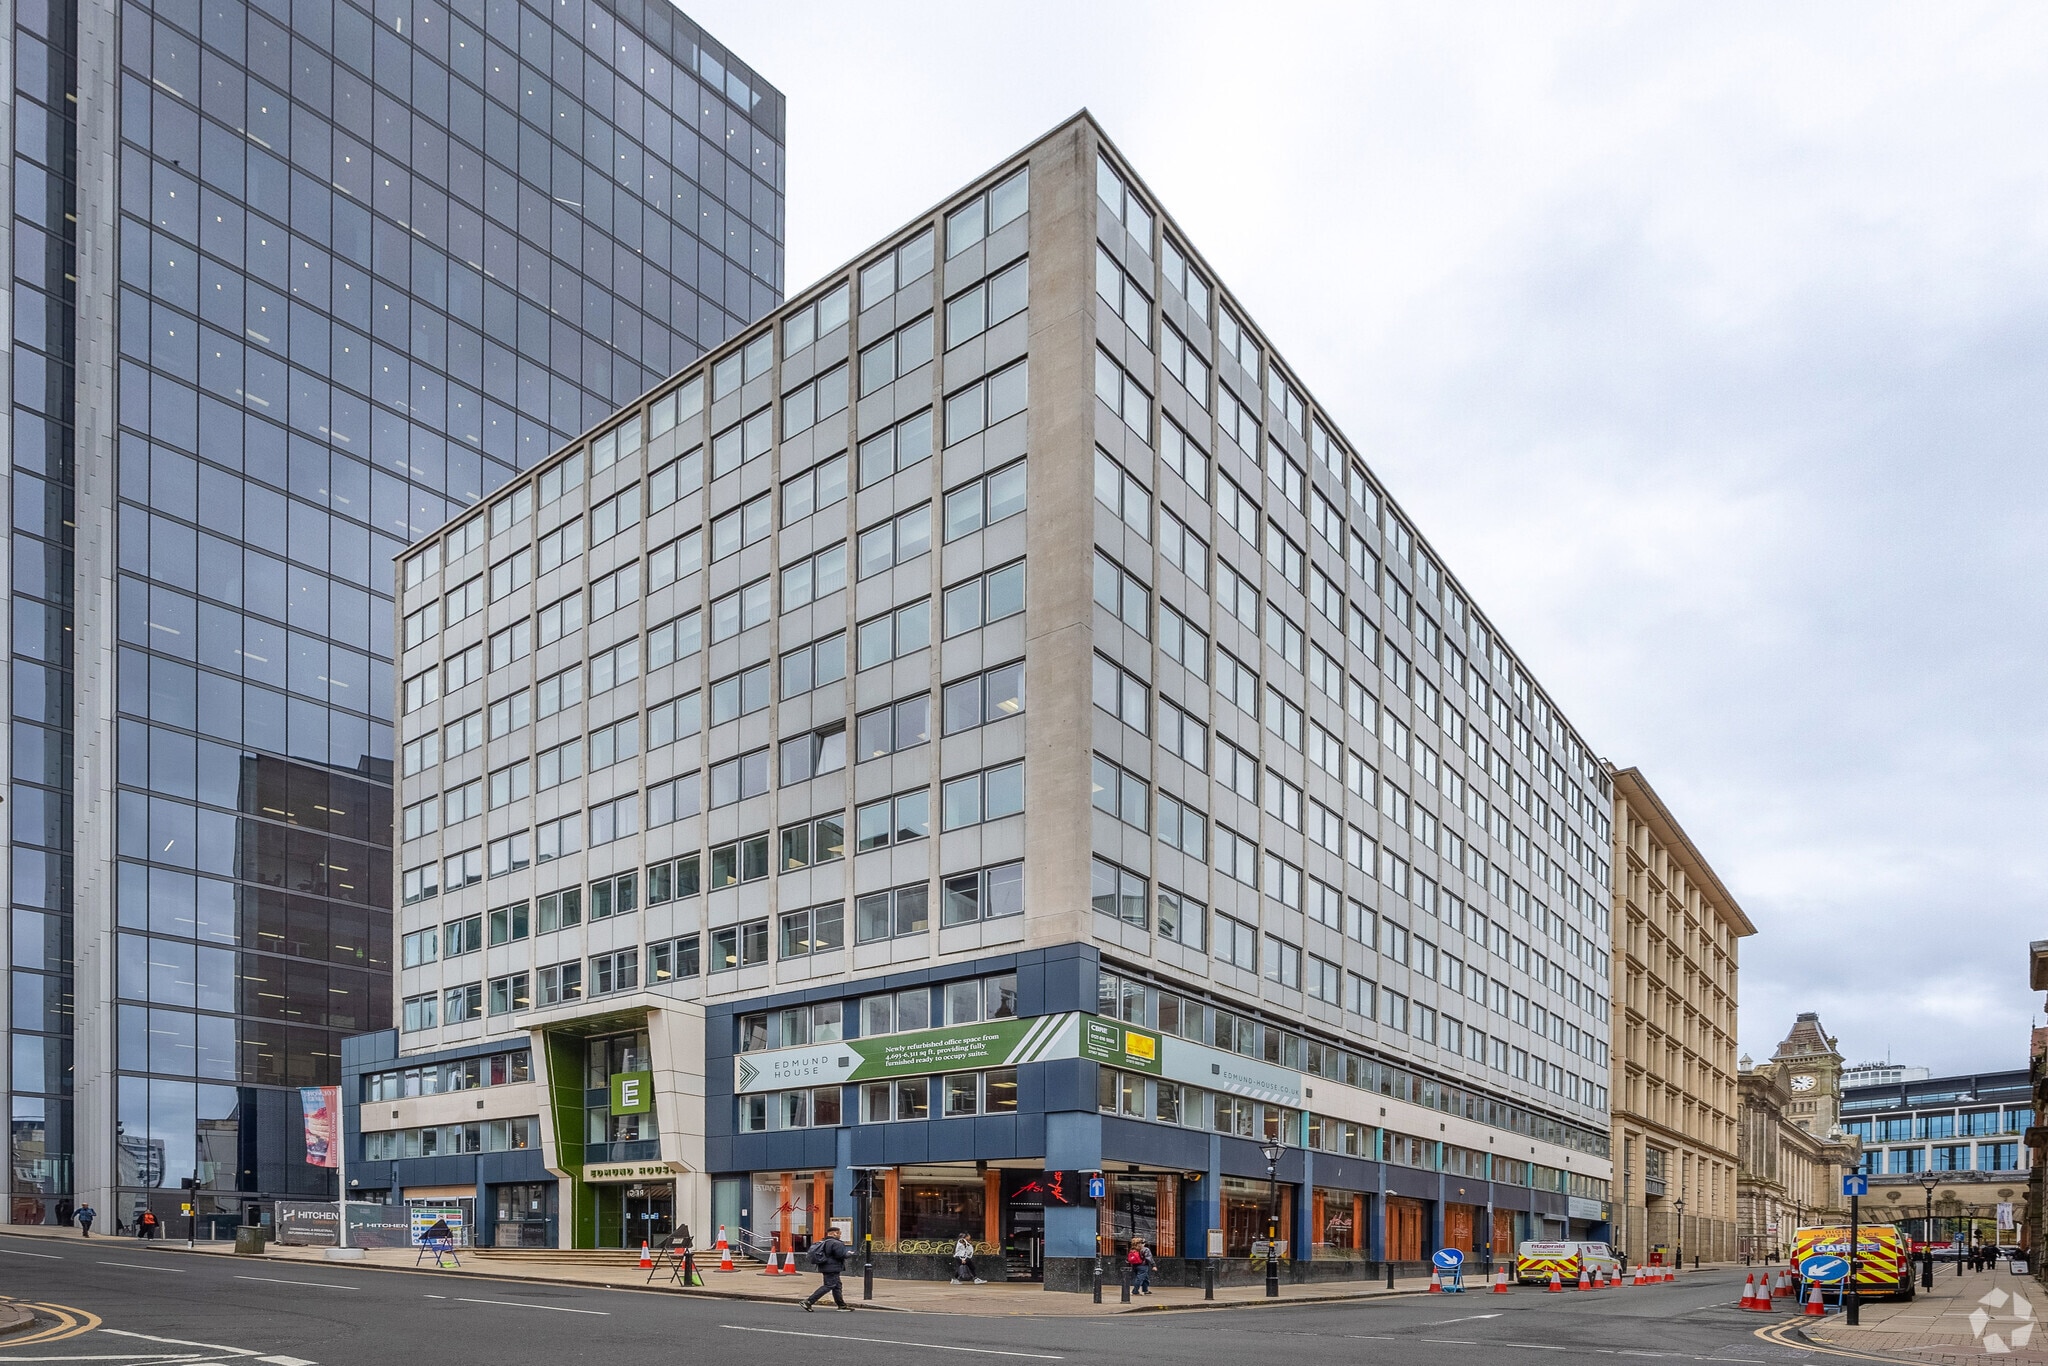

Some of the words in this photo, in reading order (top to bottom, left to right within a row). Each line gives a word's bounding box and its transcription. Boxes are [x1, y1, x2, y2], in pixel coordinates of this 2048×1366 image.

[885, 1045, 905, 1053] Newly
[907, 1040, 943, 1050] refurbished
[963, 1037, 982, 1045] space
[937, 1045, 969, 1055] providing
[970, 1042, 986, 1051] fully
[775, 1056, 829, 1069] EDMUND
[885, 1059, 915, 1067] furnished
[943, 1053, 966, 1061] occupy
[968, 1050, 989, 1058] suites.
[775, 1067, 819, 1078] HOUSE
[1223, 1071, 1299, 1095] EDMUND-HOUSE.CO.UK
[622, 1080, 640, 1106] E
[590, 1168, 634, 1178] EDMUND
[298, 1211, 339, 1220] HITCHEN
